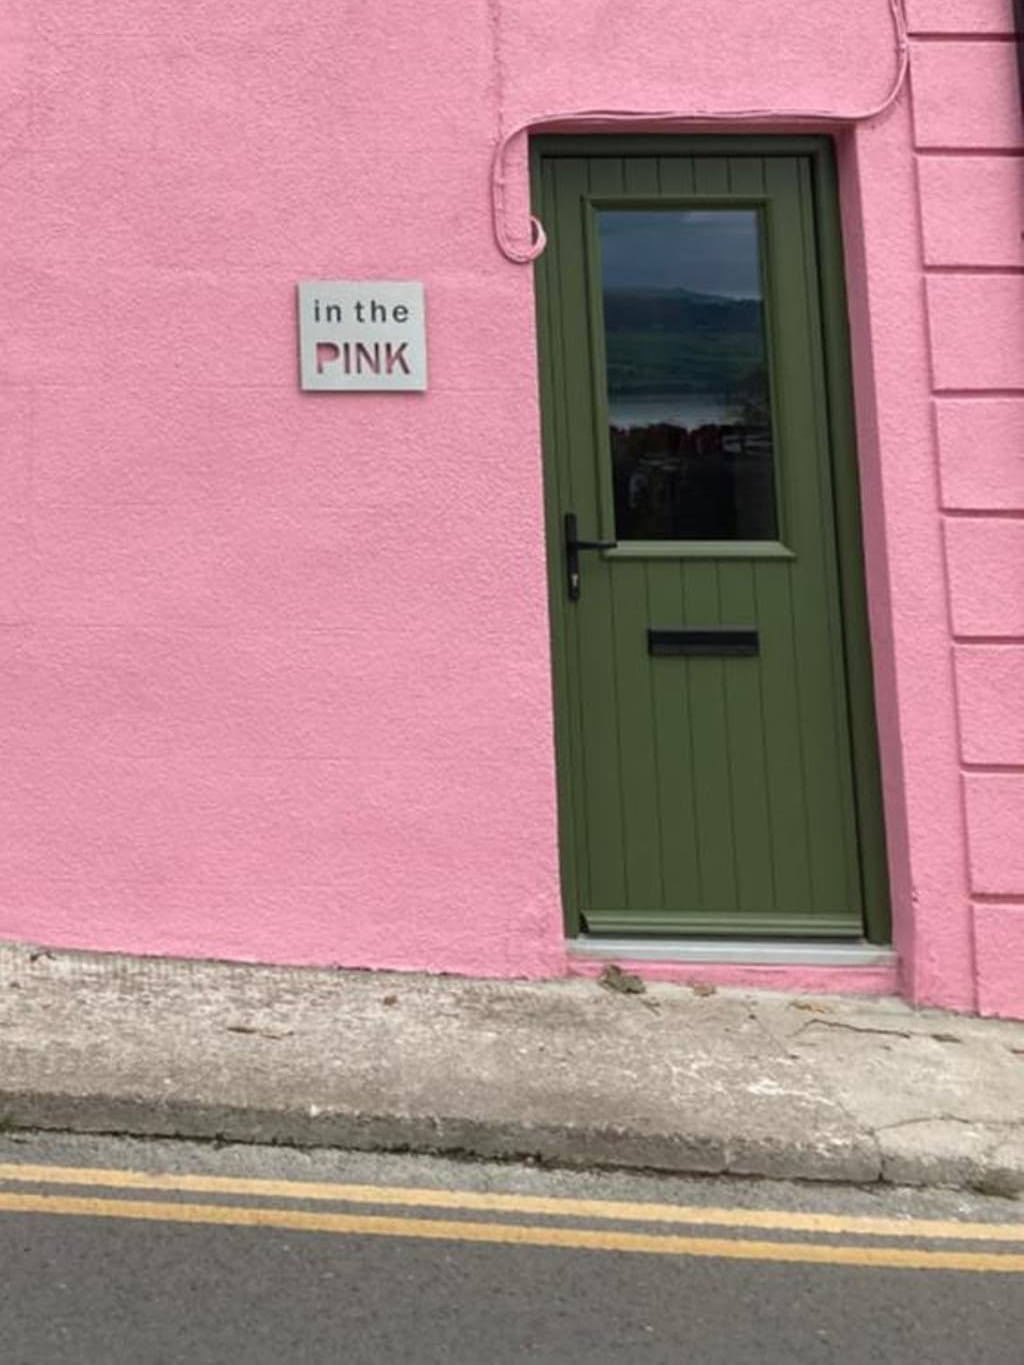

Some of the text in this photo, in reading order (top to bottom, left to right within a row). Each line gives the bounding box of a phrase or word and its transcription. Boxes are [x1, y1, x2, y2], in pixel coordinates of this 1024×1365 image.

[314, 299, 410, 324] in the
[316, 341, 411, 375] PINK
